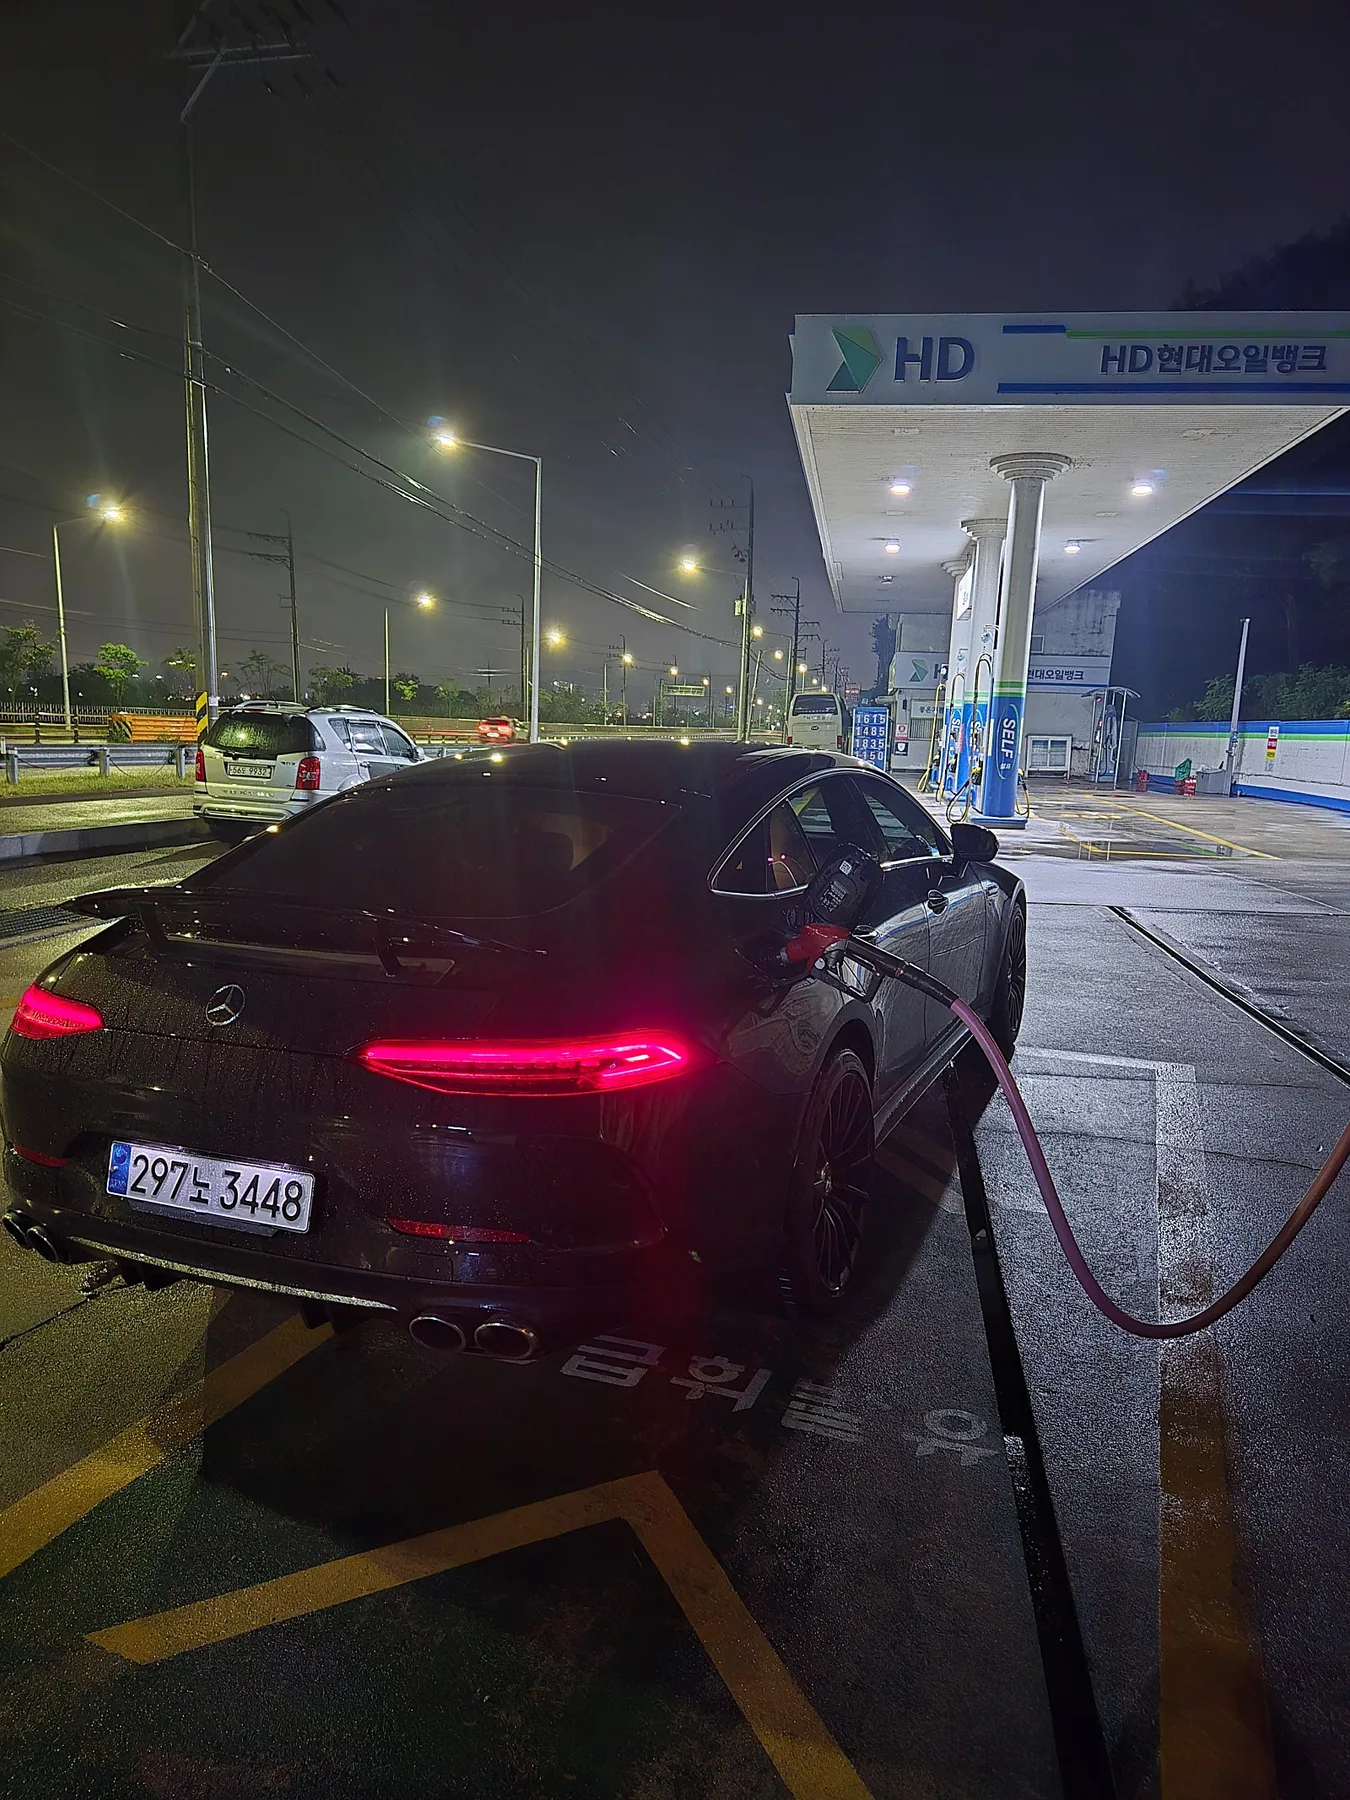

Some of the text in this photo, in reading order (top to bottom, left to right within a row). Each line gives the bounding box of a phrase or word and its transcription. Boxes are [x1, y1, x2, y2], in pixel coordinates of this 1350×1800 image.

[894, 336, 975, 383] HD
[1101, 343, 1328, 376] HD현대오일뱅크
[855, 726, 885, 736] 1485
[856, 714, 886, 724] 1615
[854, 738, 885, 748] 1835
[1001, 718, 1016, 759] SELF
[130, 1154, 303, 1222] 297노 3448
